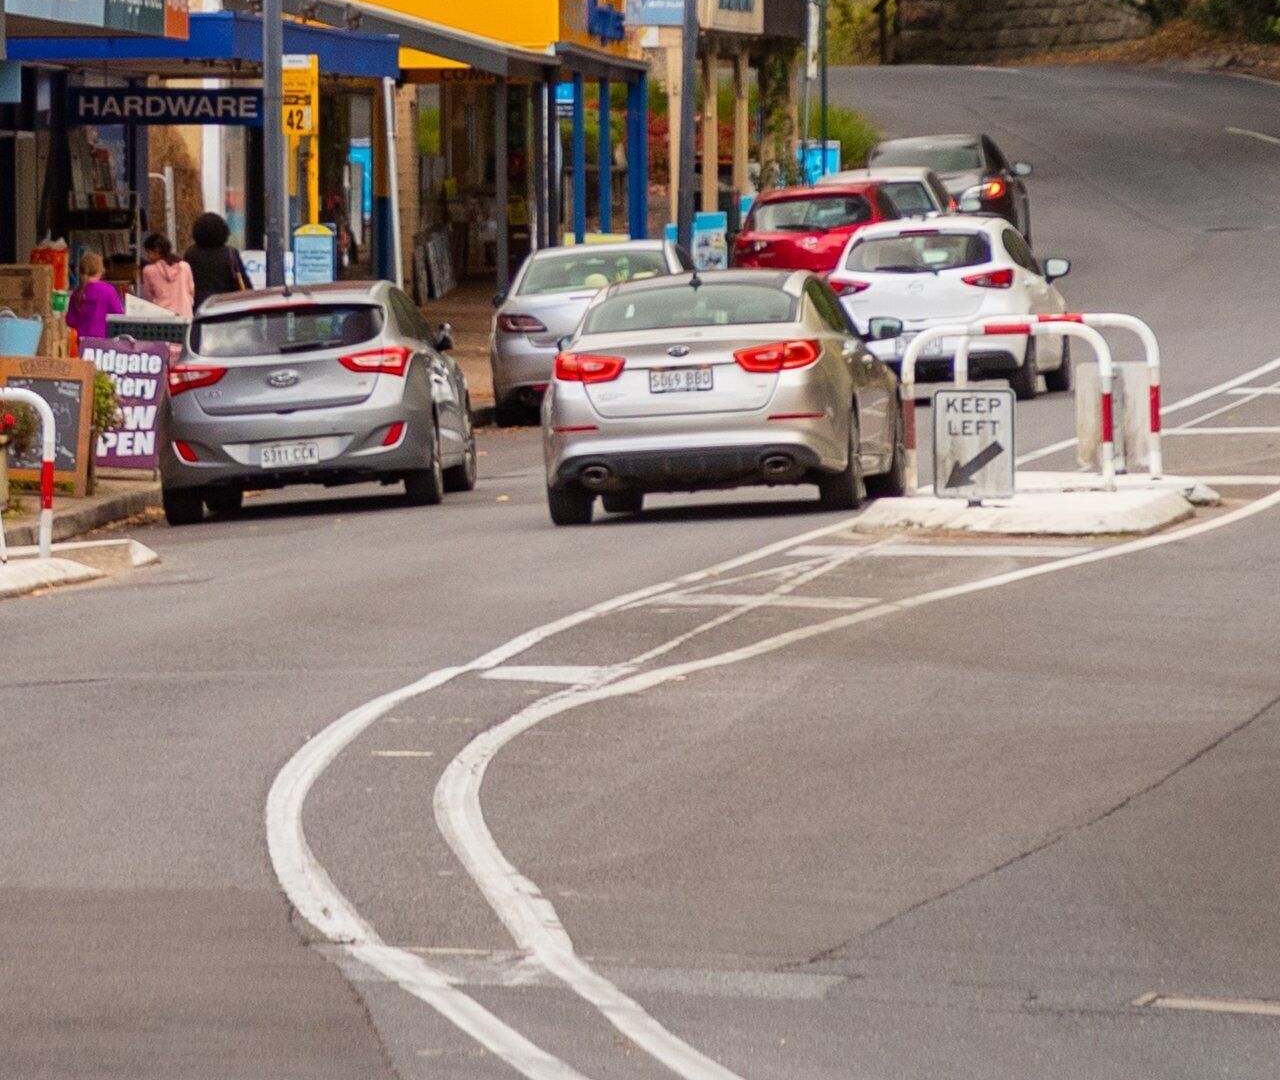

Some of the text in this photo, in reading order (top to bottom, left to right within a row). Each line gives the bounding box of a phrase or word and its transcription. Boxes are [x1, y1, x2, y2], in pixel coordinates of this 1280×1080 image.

[78, 95, 258, 118] HARDWARE
[286, 109, 305, 130] 42
[82, 348, 163, 375] Aldgate
[945, 397, 1001, 413] KEEP
[947, 420, 1000, 436] LEFT
[95, 430, 156, 457] PEN
